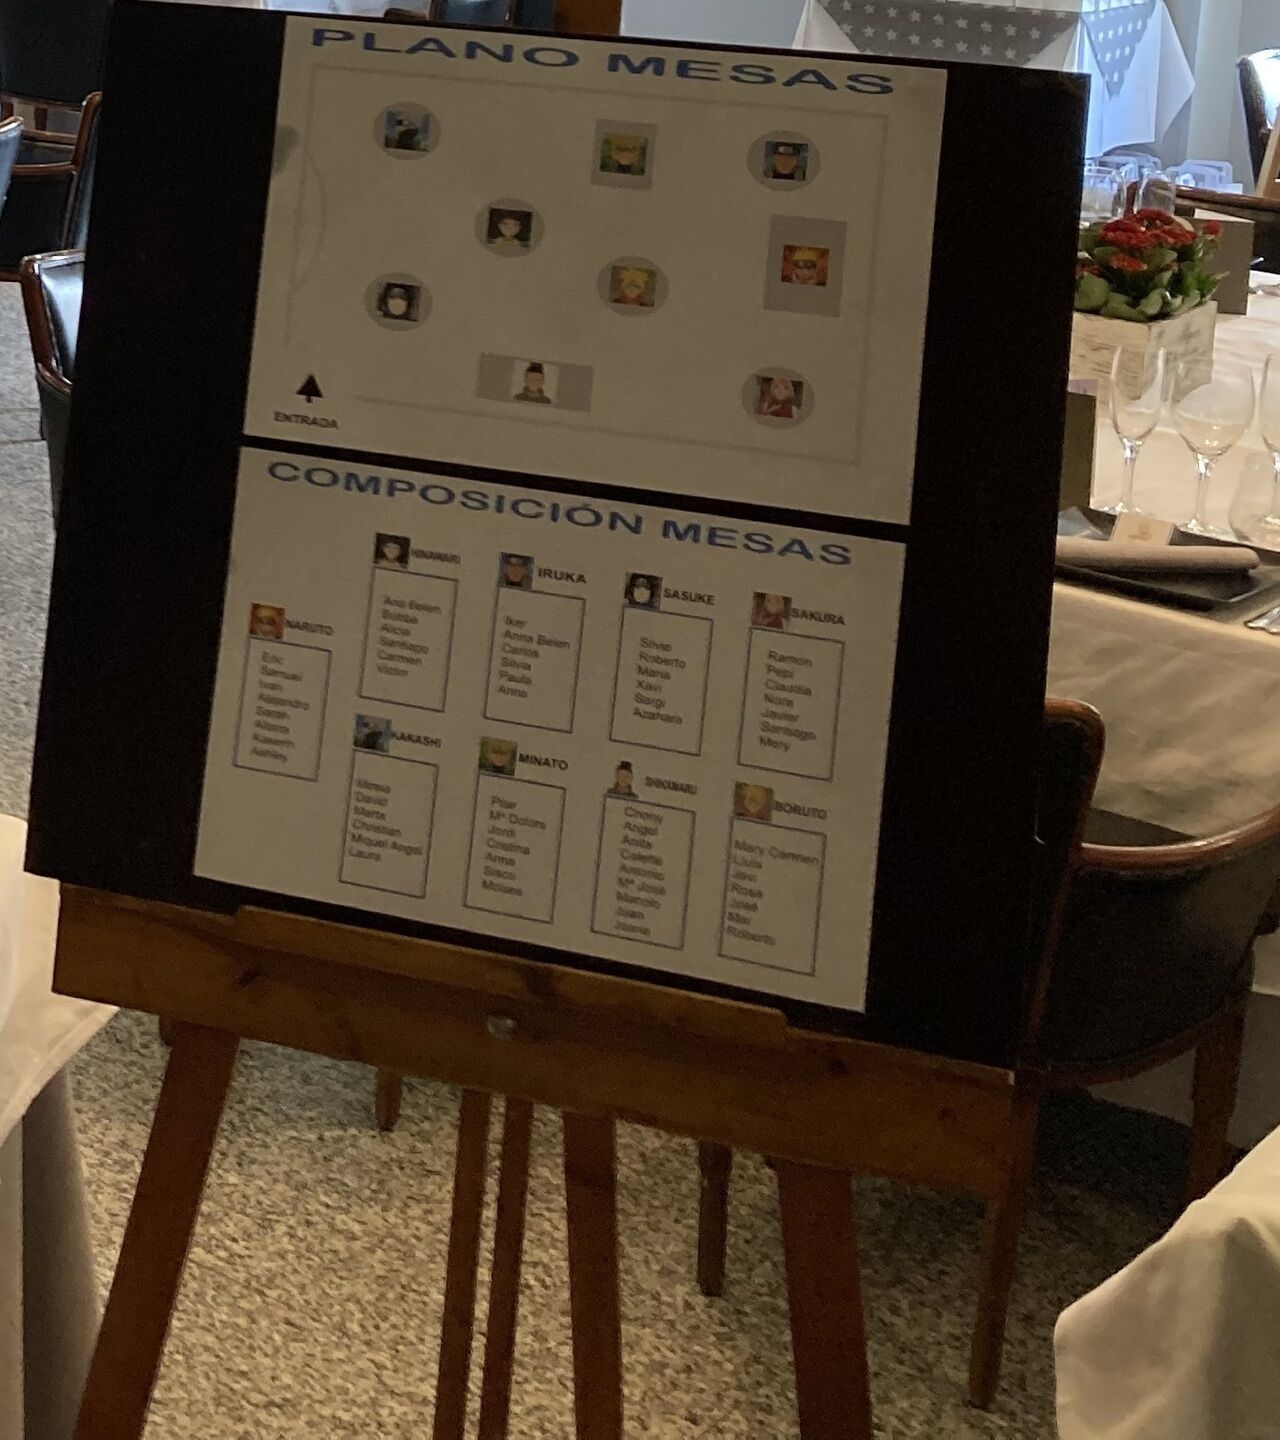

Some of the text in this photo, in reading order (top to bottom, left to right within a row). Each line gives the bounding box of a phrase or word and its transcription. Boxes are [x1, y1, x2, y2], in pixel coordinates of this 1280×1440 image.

[311, 27, 895, 97] PLANO MESAS
[274, 411, 340, 430] ENTRADA
[265, 460, 854, 567] COMPOSICIÓN MESAS
[537, 566, 587, 584] IRUKA
[663, 587, 716, 606] SASUKE
[791, 606, 846, 626] SAKURA
[286, 618, 334, 637] NARUTO
[639, 651, 687, 669] Roberto
[518, 752, 569, 771] MINATO
[774, 800, 828, 820] BORUTO
